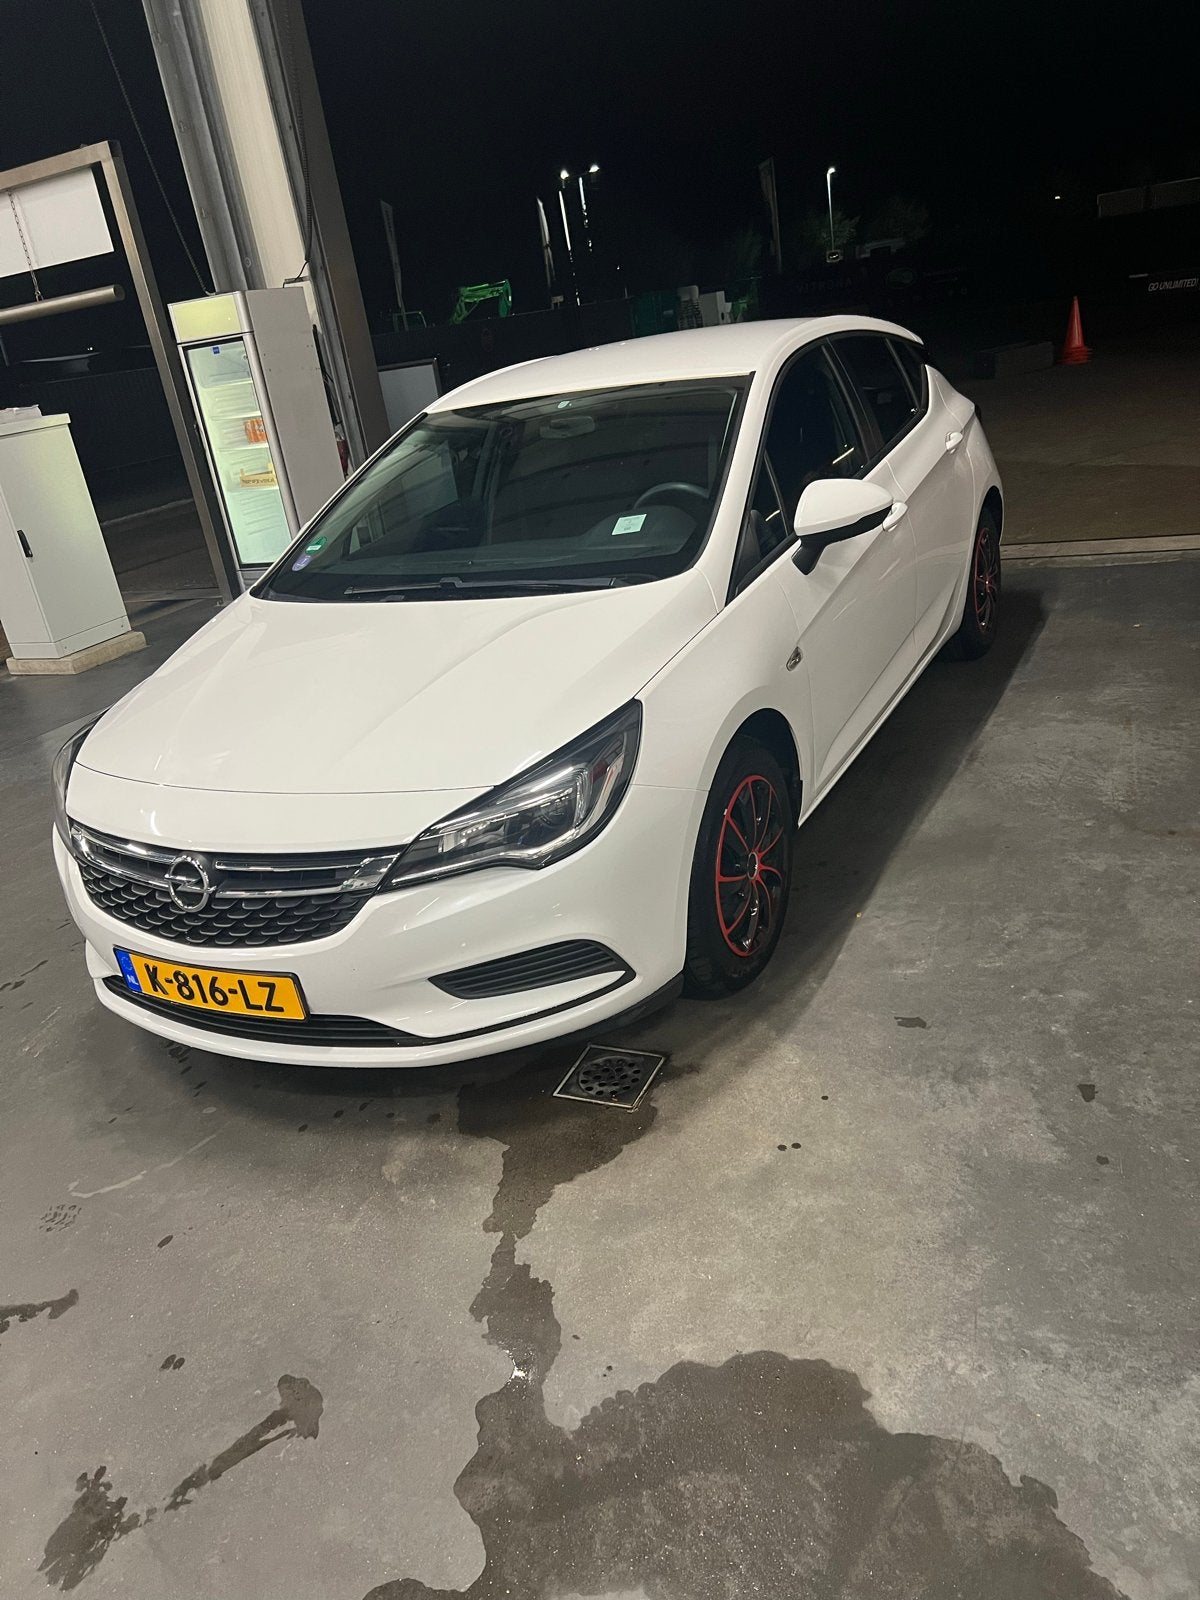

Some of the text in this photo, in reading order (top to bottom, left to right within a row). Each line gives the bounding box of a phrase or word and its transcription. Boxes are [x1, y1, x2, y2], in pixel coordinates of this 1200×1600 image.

[1148, 282, 1159, 292] GO
[127, 974, 139, 985] NL
[144, 963, 284, 1012] K-816-LZ
